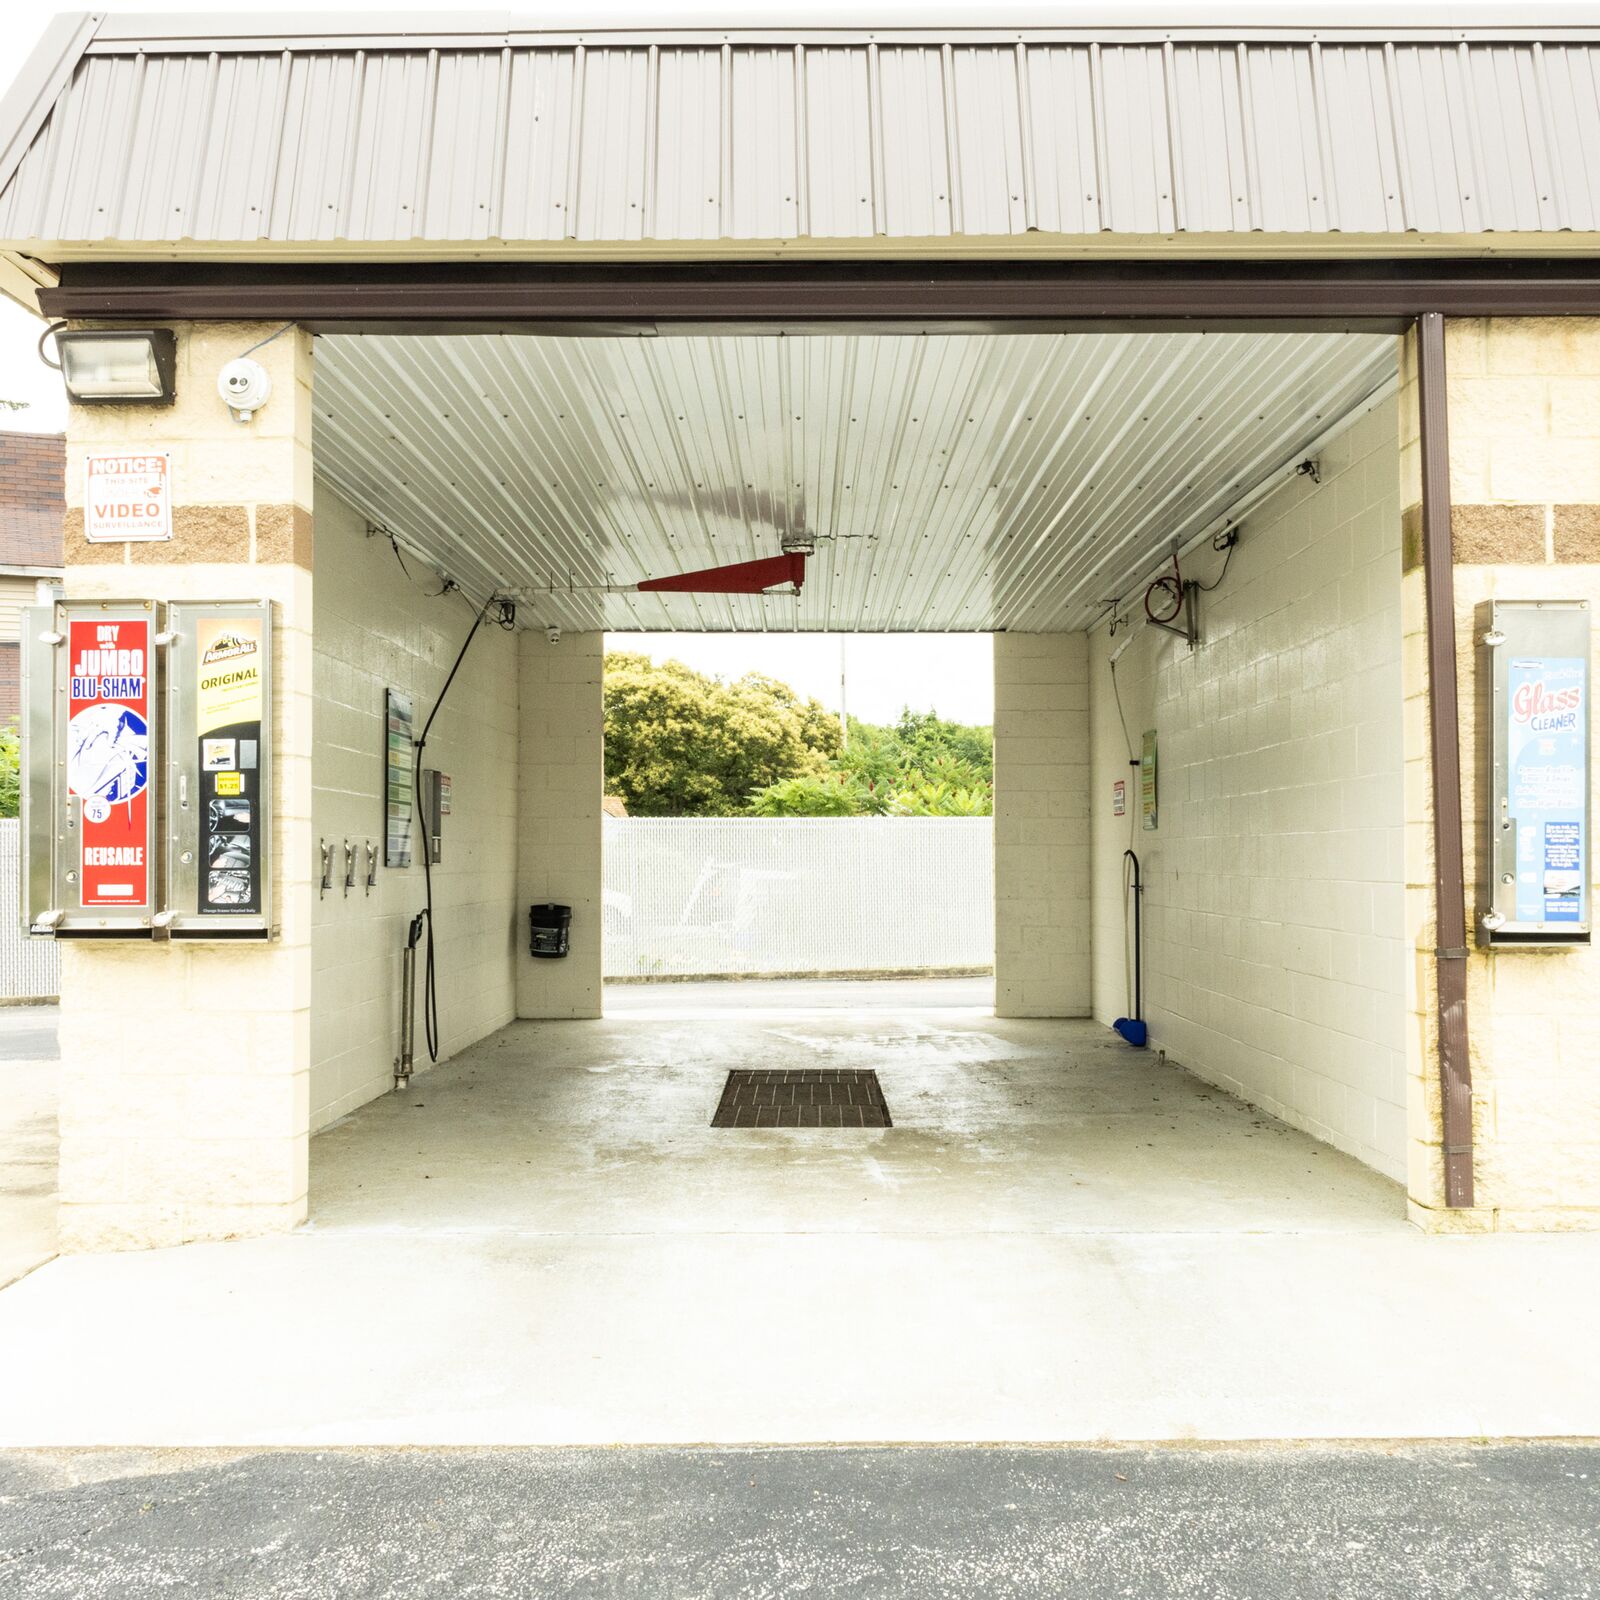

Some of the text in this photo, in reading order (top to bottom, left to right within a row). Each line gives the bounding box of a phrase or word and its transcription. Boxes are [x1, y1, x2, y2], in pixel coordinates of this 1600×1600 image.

[94, 503, 161, 518] VIDEO
[97, 625, 120, 642] DRY
[74, 649, 144, 676] JUMBO
[72, 677, 141, 698] BLU-SHAM
[201, 667, 259, 690] ORIGINAL
[1514, 682, 1580, 724] Glass
[1530, 712, 1576, 731] CLEANER
[92, 809, 102, 819] 75
[84, 847, 143, 866] REUSABLE
